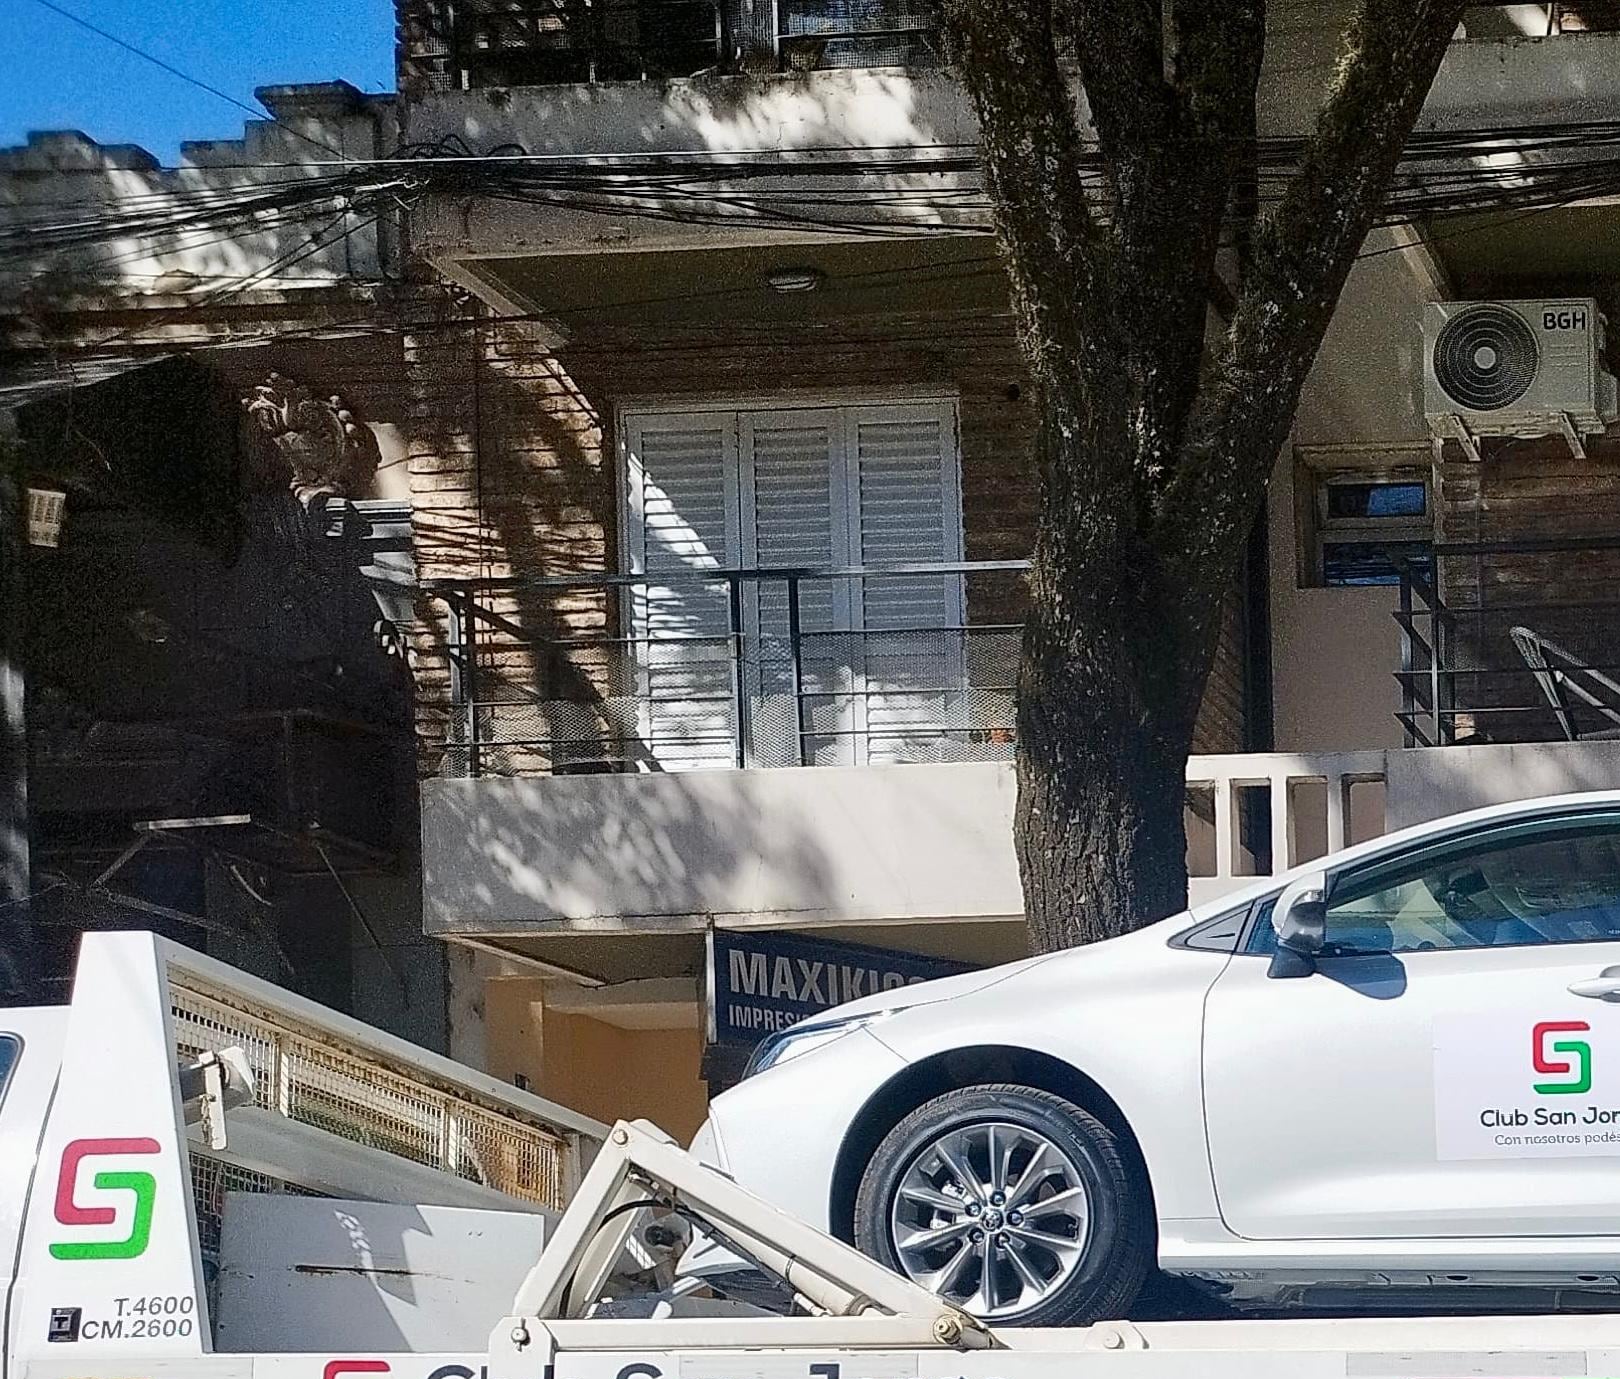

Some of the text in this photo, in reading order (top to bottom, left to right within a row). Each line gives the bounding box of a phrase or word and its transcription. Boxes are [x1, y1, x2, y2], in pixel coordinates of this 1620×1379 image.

[1543, 312, 1586, 330] BGH
[728, 949, 926, 1005] MAXIKI
[729, 1004, 810, 1032] IMPRES
[1480, 1109, 1528, 1127] Club
[1534, 1108, 1576, 1126] San
[1495, 1134, 1521, 1145] Con
[1525, 1133, 1581, 1145] nosotros
[114, 1296, 194, 1317] T.4600
[81, 1319, 193, 1340] CM.2600
